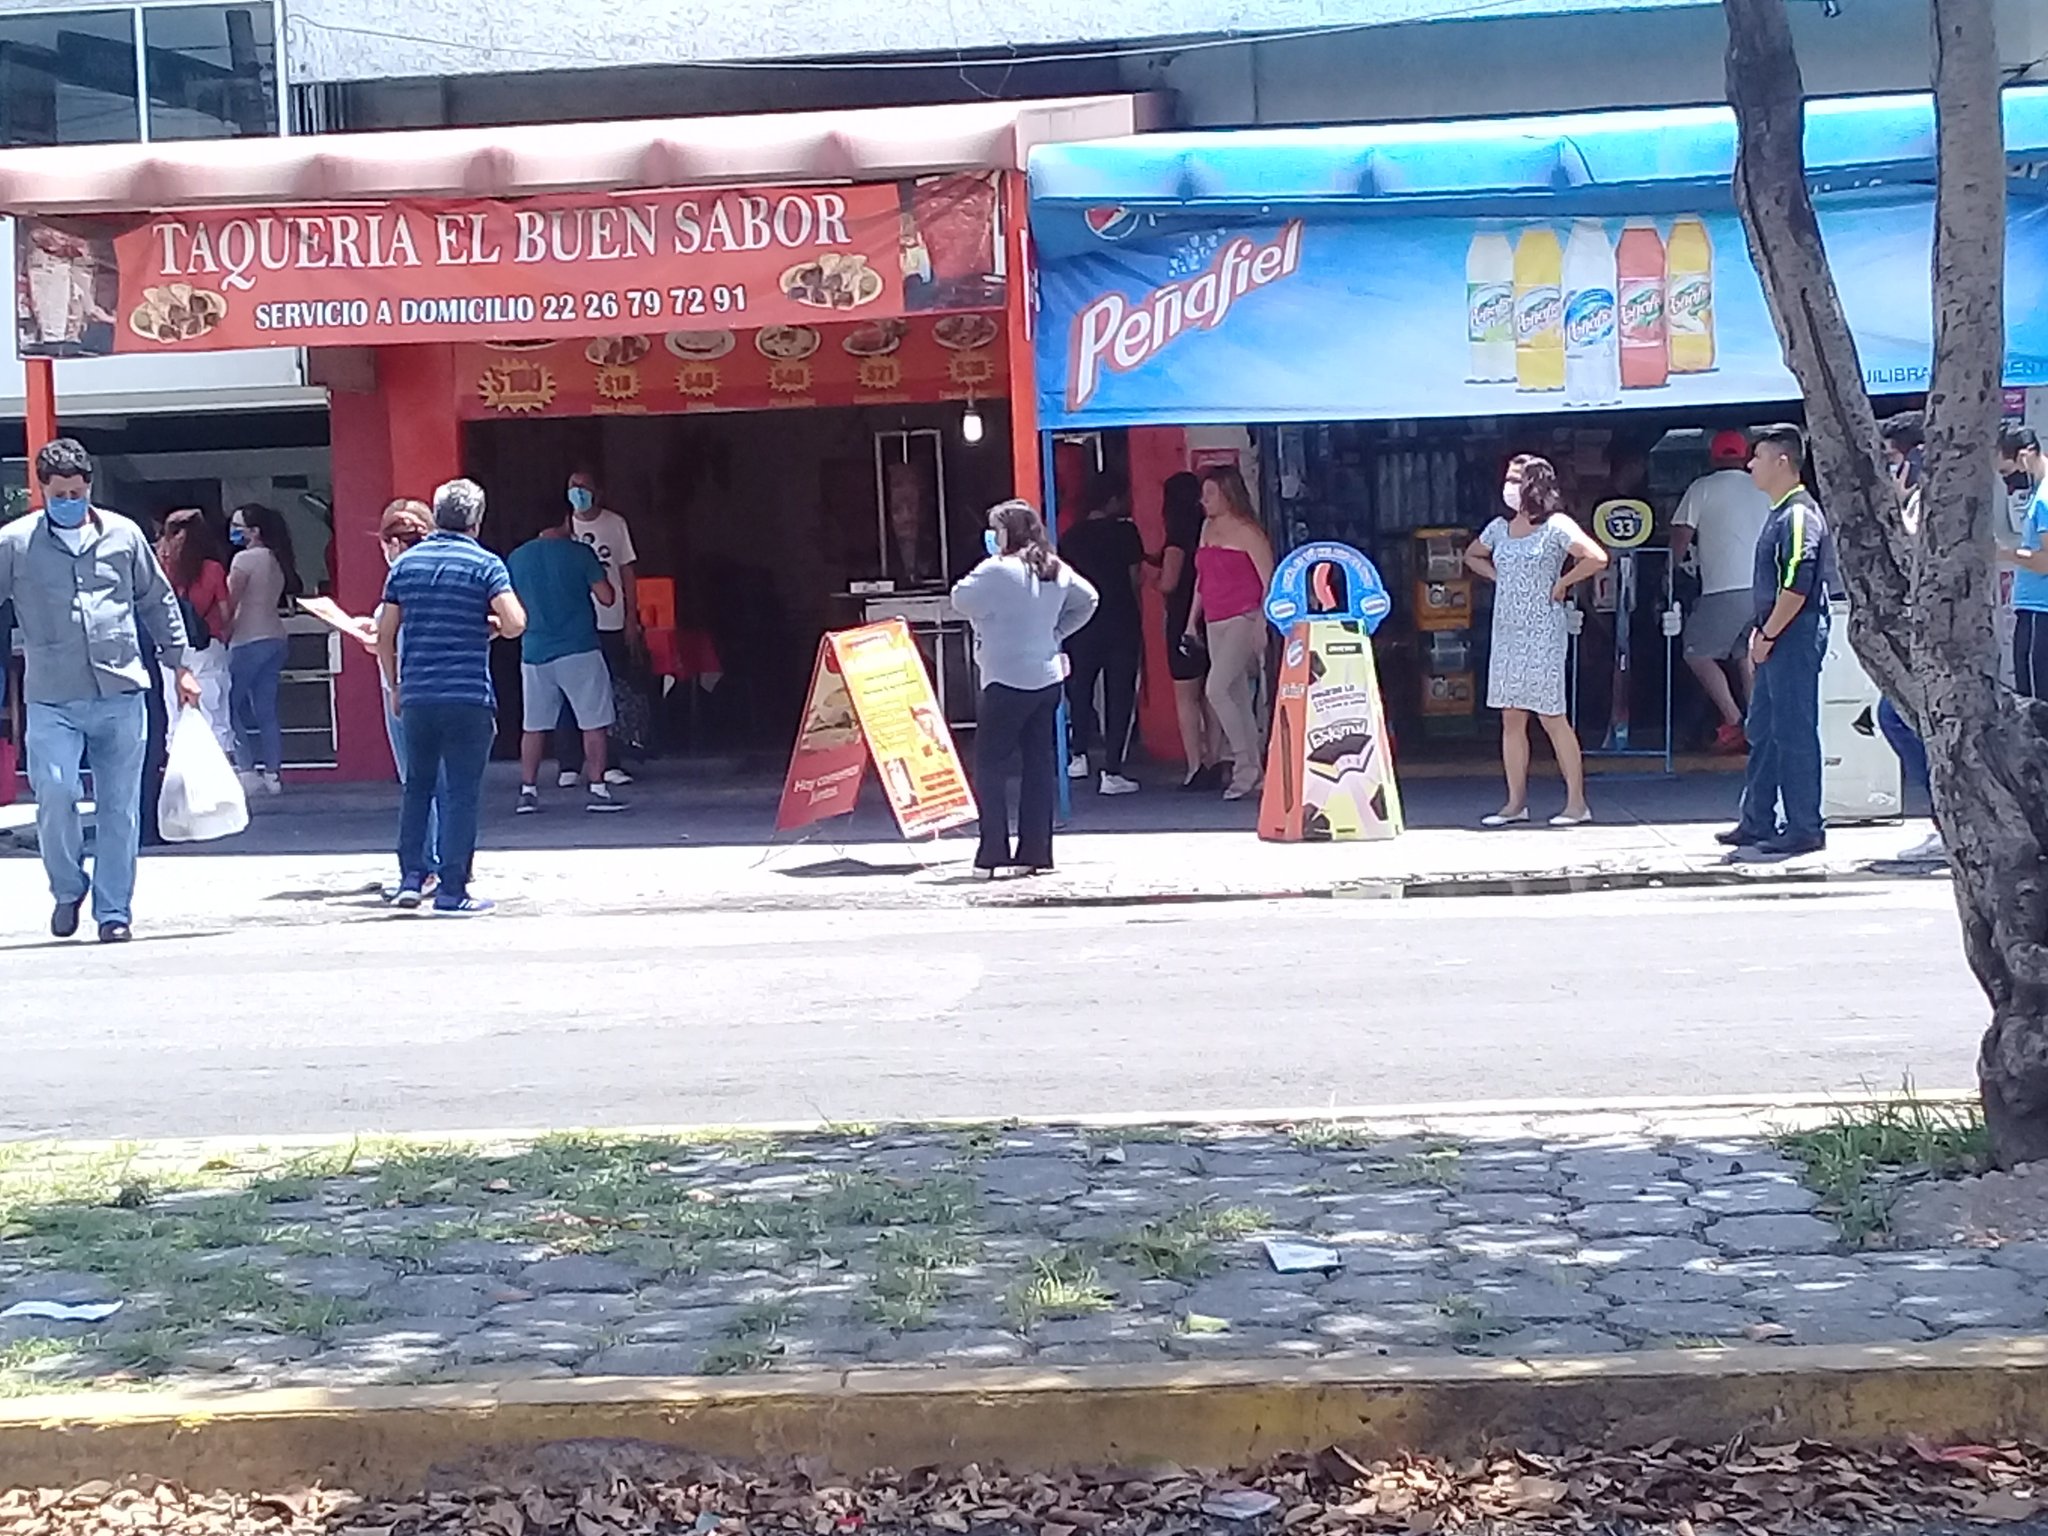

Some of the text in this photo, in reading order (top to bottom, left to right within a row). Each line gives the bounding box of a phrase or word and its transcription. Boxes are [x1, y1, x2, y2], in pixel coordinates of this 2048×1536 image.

[152, 192, 853, 292] TAQUERIA EL BUEN SABOR
[254, 284, 747, 330] SERVICIO A DOMICILIO 22 26 79 72 91
[1070, 218, 1302, 410] Peñafiel
[1612, 519, 1635, 537] 33
